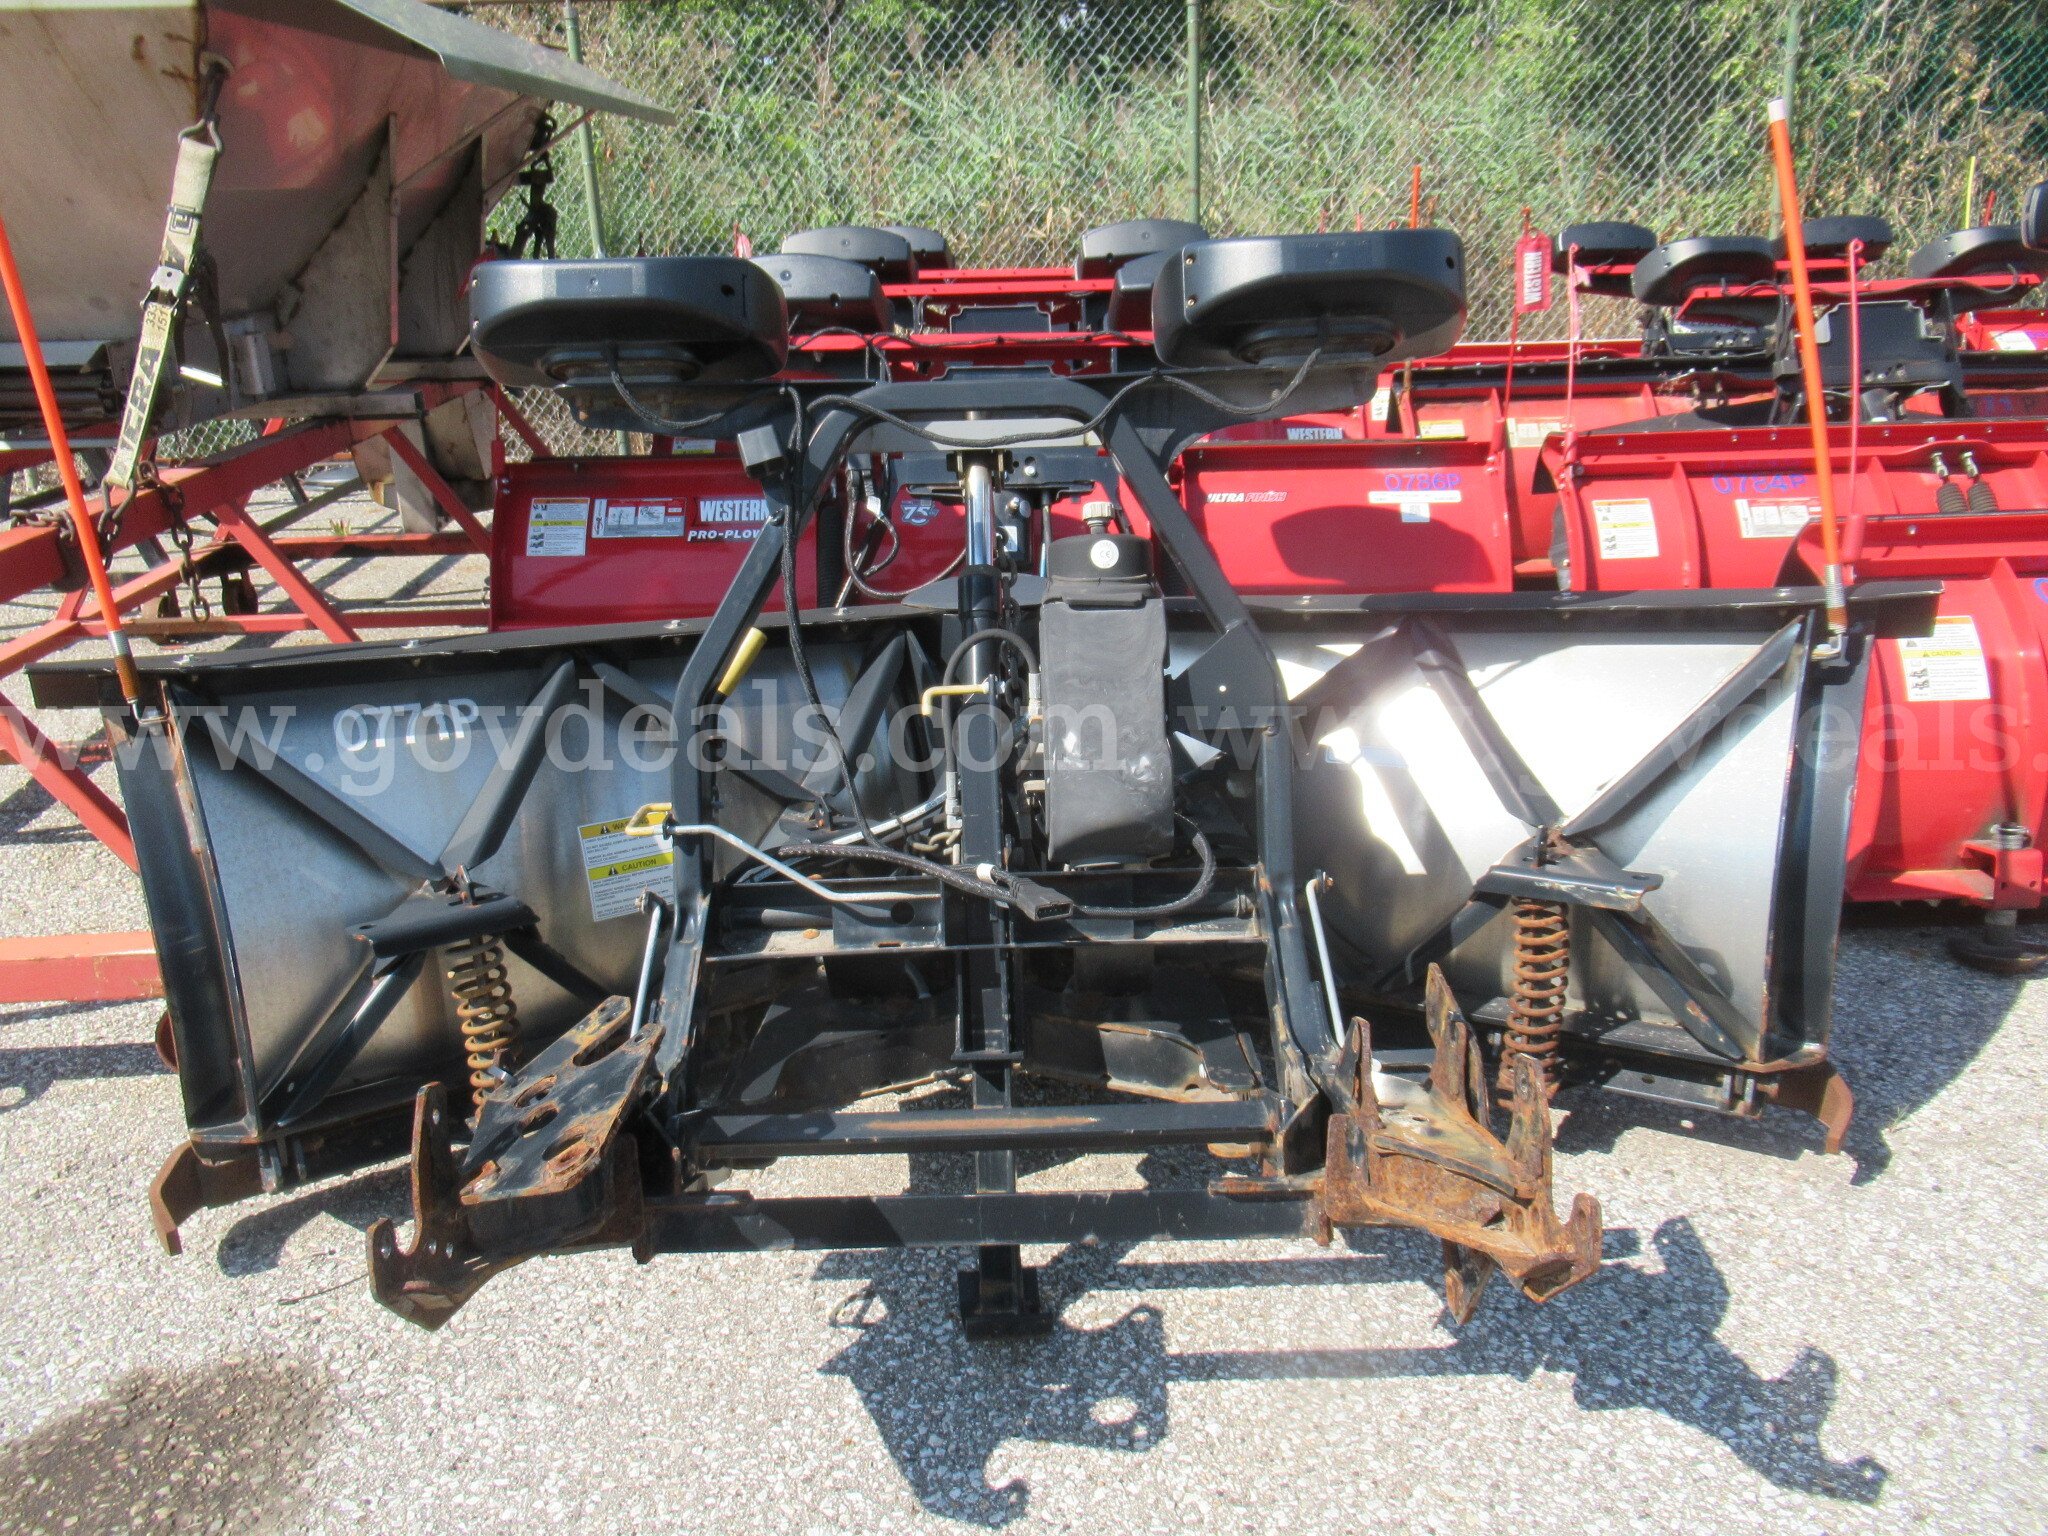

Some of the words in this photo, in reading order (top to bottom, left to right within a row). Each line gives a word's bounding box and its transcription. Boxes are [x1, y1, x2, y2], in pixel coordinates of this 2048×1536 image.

[1524, 252, 1543, 305] WESTERN
[1286, 427, 1344, 440] WESTERN
[622, 858, 657, 872] CAUTION
